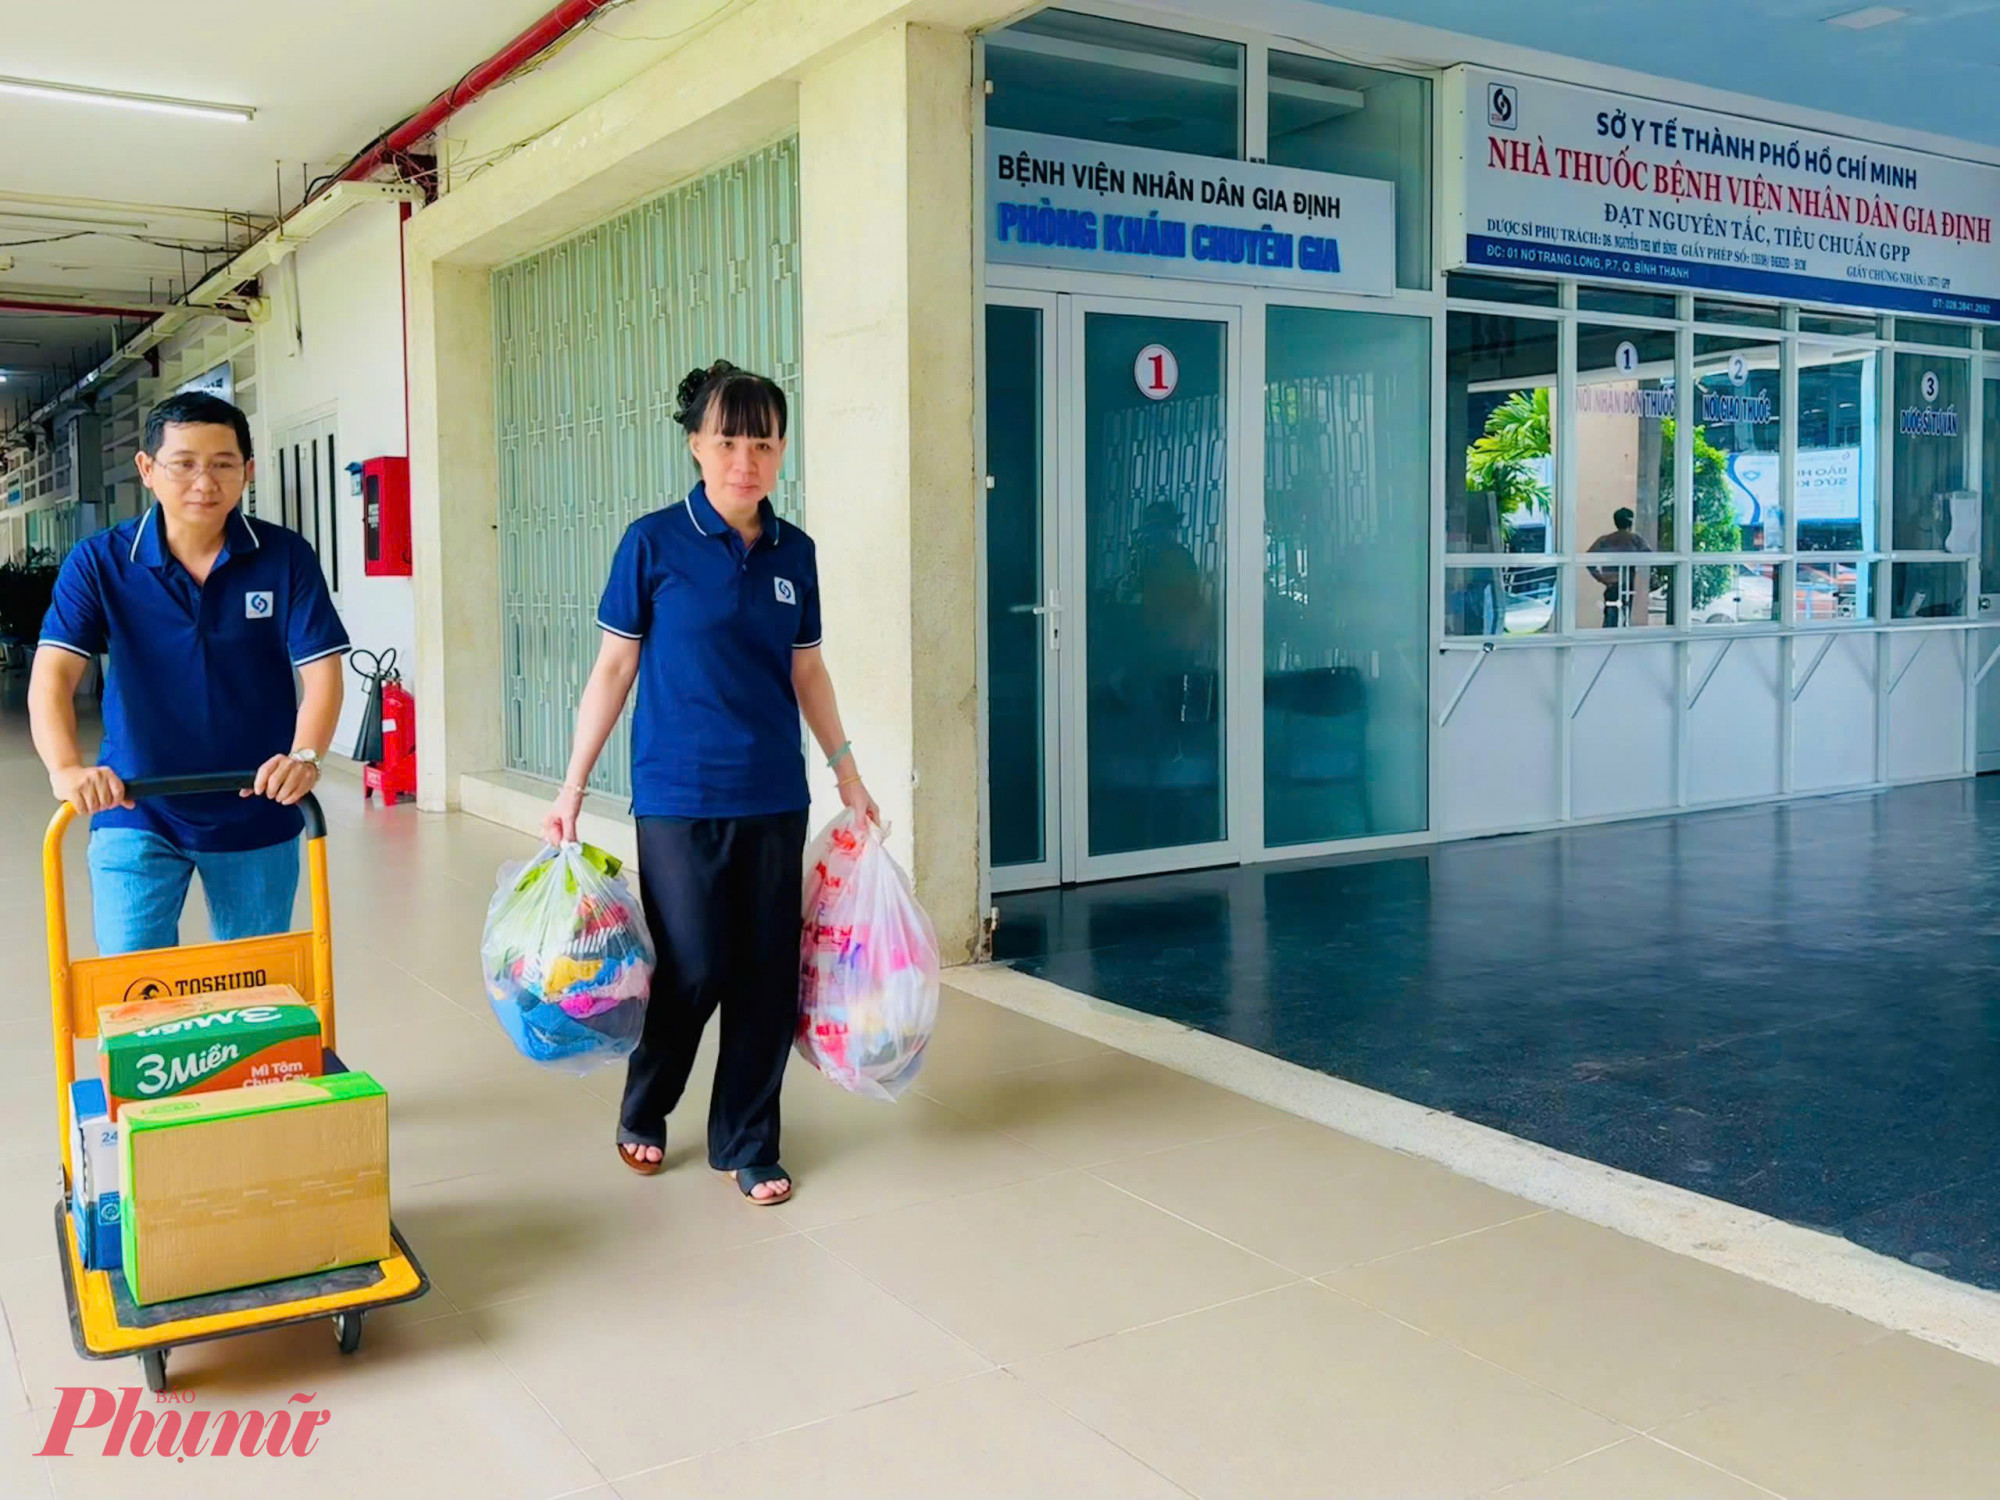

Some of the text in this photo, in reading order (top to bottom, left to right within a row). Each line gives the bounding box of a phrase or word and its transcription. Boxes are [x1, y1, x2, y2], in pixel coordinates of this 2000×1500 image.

[1597, 108, 1917, 190] SỞ Y TẾ THÀNH PHỐ HỒ CHÍ MINH
[999, 152, 1340, 220] BỆNH VIỆN NHÂN DÂN GIA ĐỊNH
[1488, 135, 1991, 245] NHÀ THUỐC BỆNH VIỆN NHÂN DÂN GIA ĐỊNH
[997, 197, 1341, 273] PHÒNG KHÁM CHUYÊN GIA
[1487, 219, 1520, 235] DƯỢC
[1535, 225, 1559, 241] PHỤ
[1562, 228, 1601, 246] TRÁCH:
[1682, 242, 1706, 258] GIẤY
[1707, 245, 1733, 262] PHÉP
[1734, 245, 1750, 263] SỐ:
[1605, 203, 1910, 262] ĐẠT NGUYÊN TẮC, TIÊU CHUẨN GPP
[1487, 244, 1505, 257] ĐC:
[1507, 247, 1518, 259] 01
[1538, 251, 1571, 265] TRANG
[1573, 255, 1604, 271] LONG,
[1622, 260, 1632, 273] Q.
[1635, 261, 1657, 275] BÌNH
[1658, 265, 1689, 279] THẠNH
[1847, 264, 1868, 279] GIẤY
[1900, 271, 1926, 286] NHẬN:
[1147, 354, 1169, 390] 1
[1623, 348, 1631, 370] 1
[1734, 359, 1743, 380] 2
[1926, 378, 1935, 397] 3
[1702, 388, 1771, 424] NƠI GIAO THUỐC
[271, 1061, 303, 1074] Tôm
